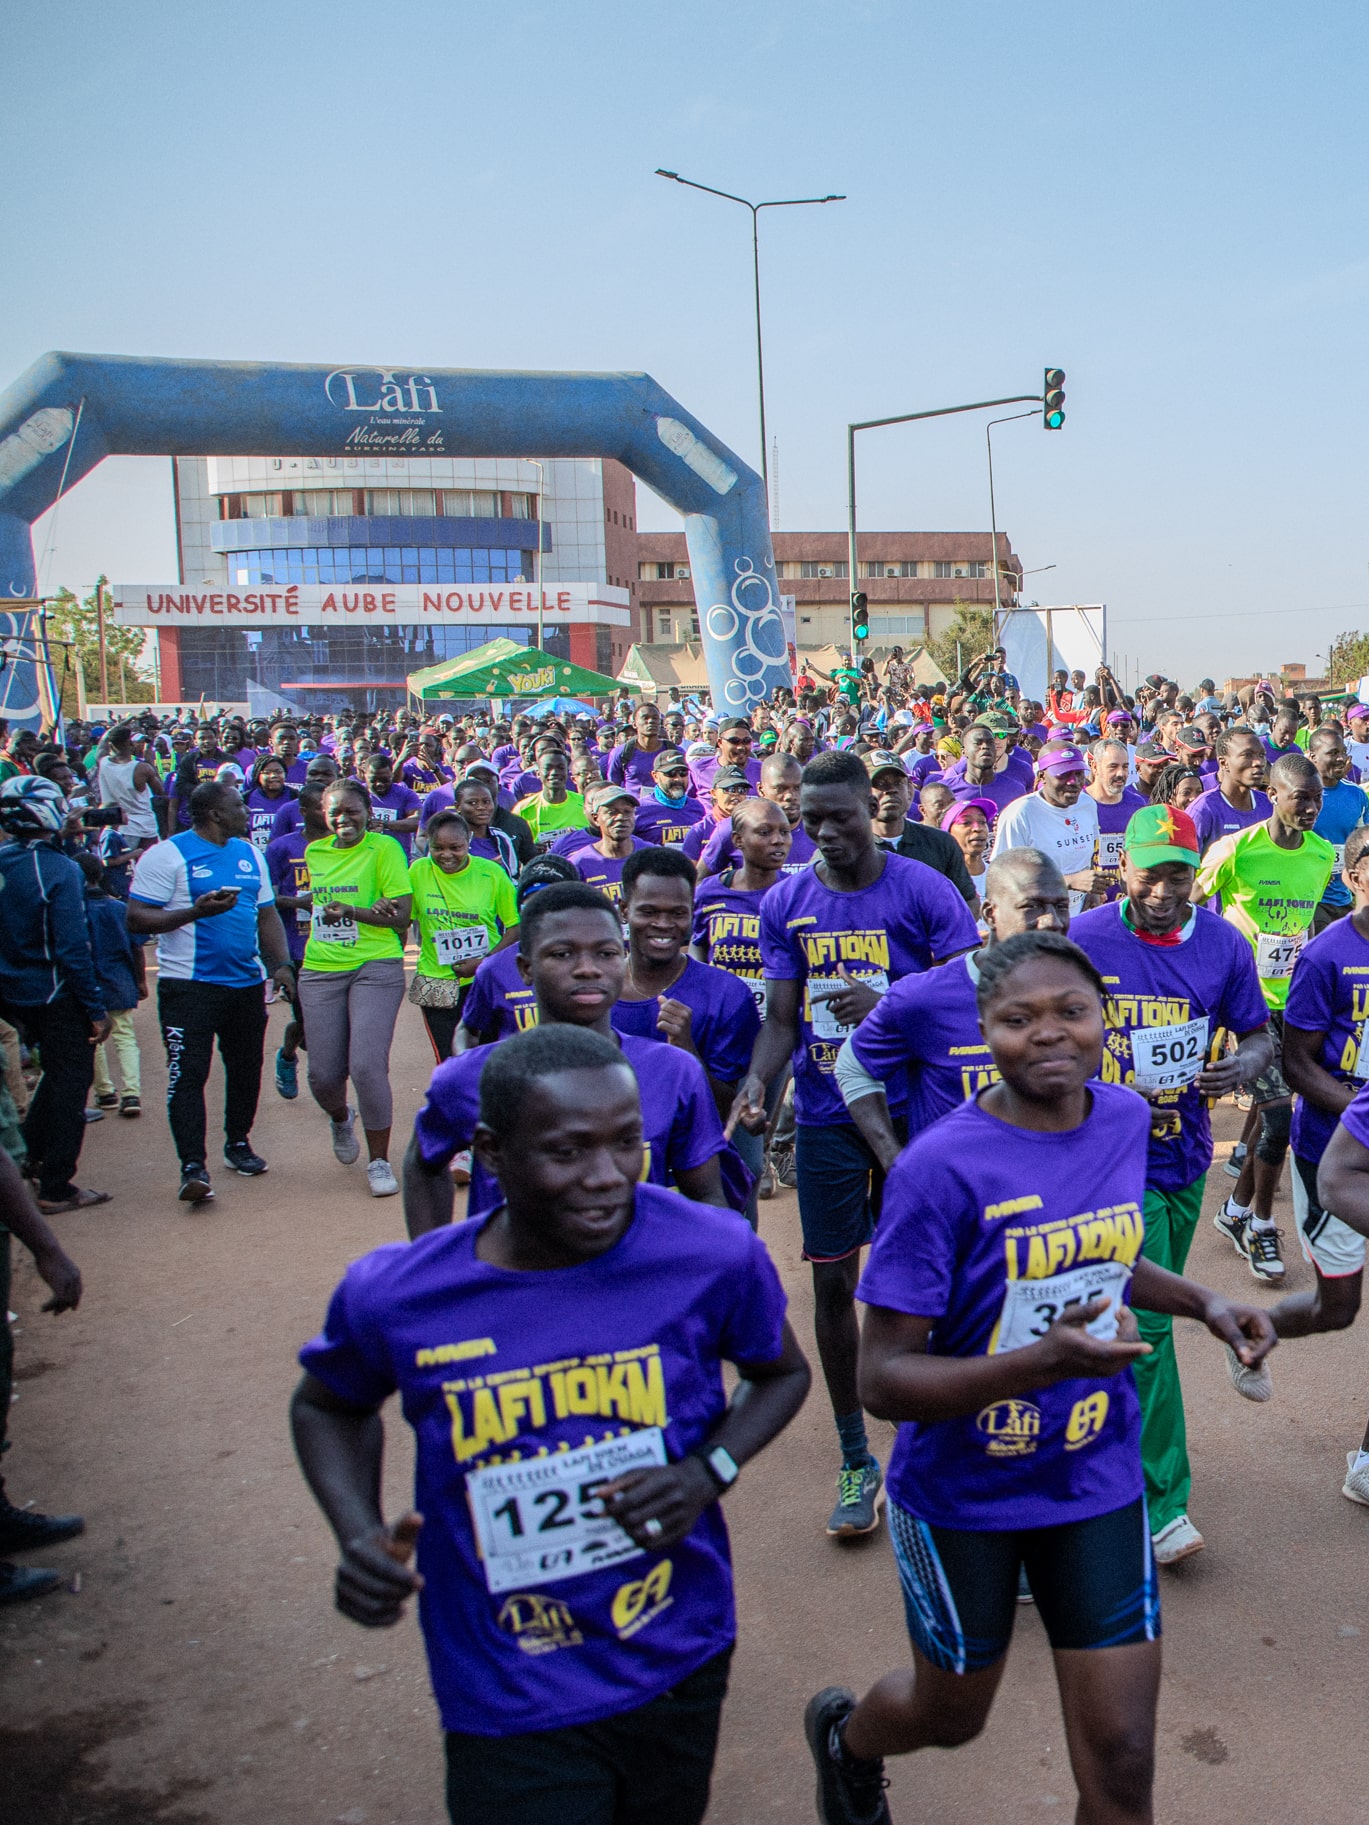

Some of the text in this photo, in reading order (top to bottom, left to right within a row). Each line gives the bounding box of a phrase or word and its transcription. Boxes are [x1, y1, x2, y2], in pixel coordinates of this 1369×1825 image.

[369, 416, 426, 425] L'eau minérale
[346, 426, 444, 445] Naturelle du
[147, 586, 572, 615] UNIVERSITÉ AUBE NOUVELLE
[1258, 898, 1314, 909] LAFI 10KM
[440, 934, 485, 950] 1017
[839, 934, 890, 971] 10KM
[1141, 1001, 1190, 1027] 10KM
[1151, 1036, 1198, 1067] 502
[1005, 1228, 1076, 1281] LAFI
[445, 1354, 668, 1462] LAFI 10KM
